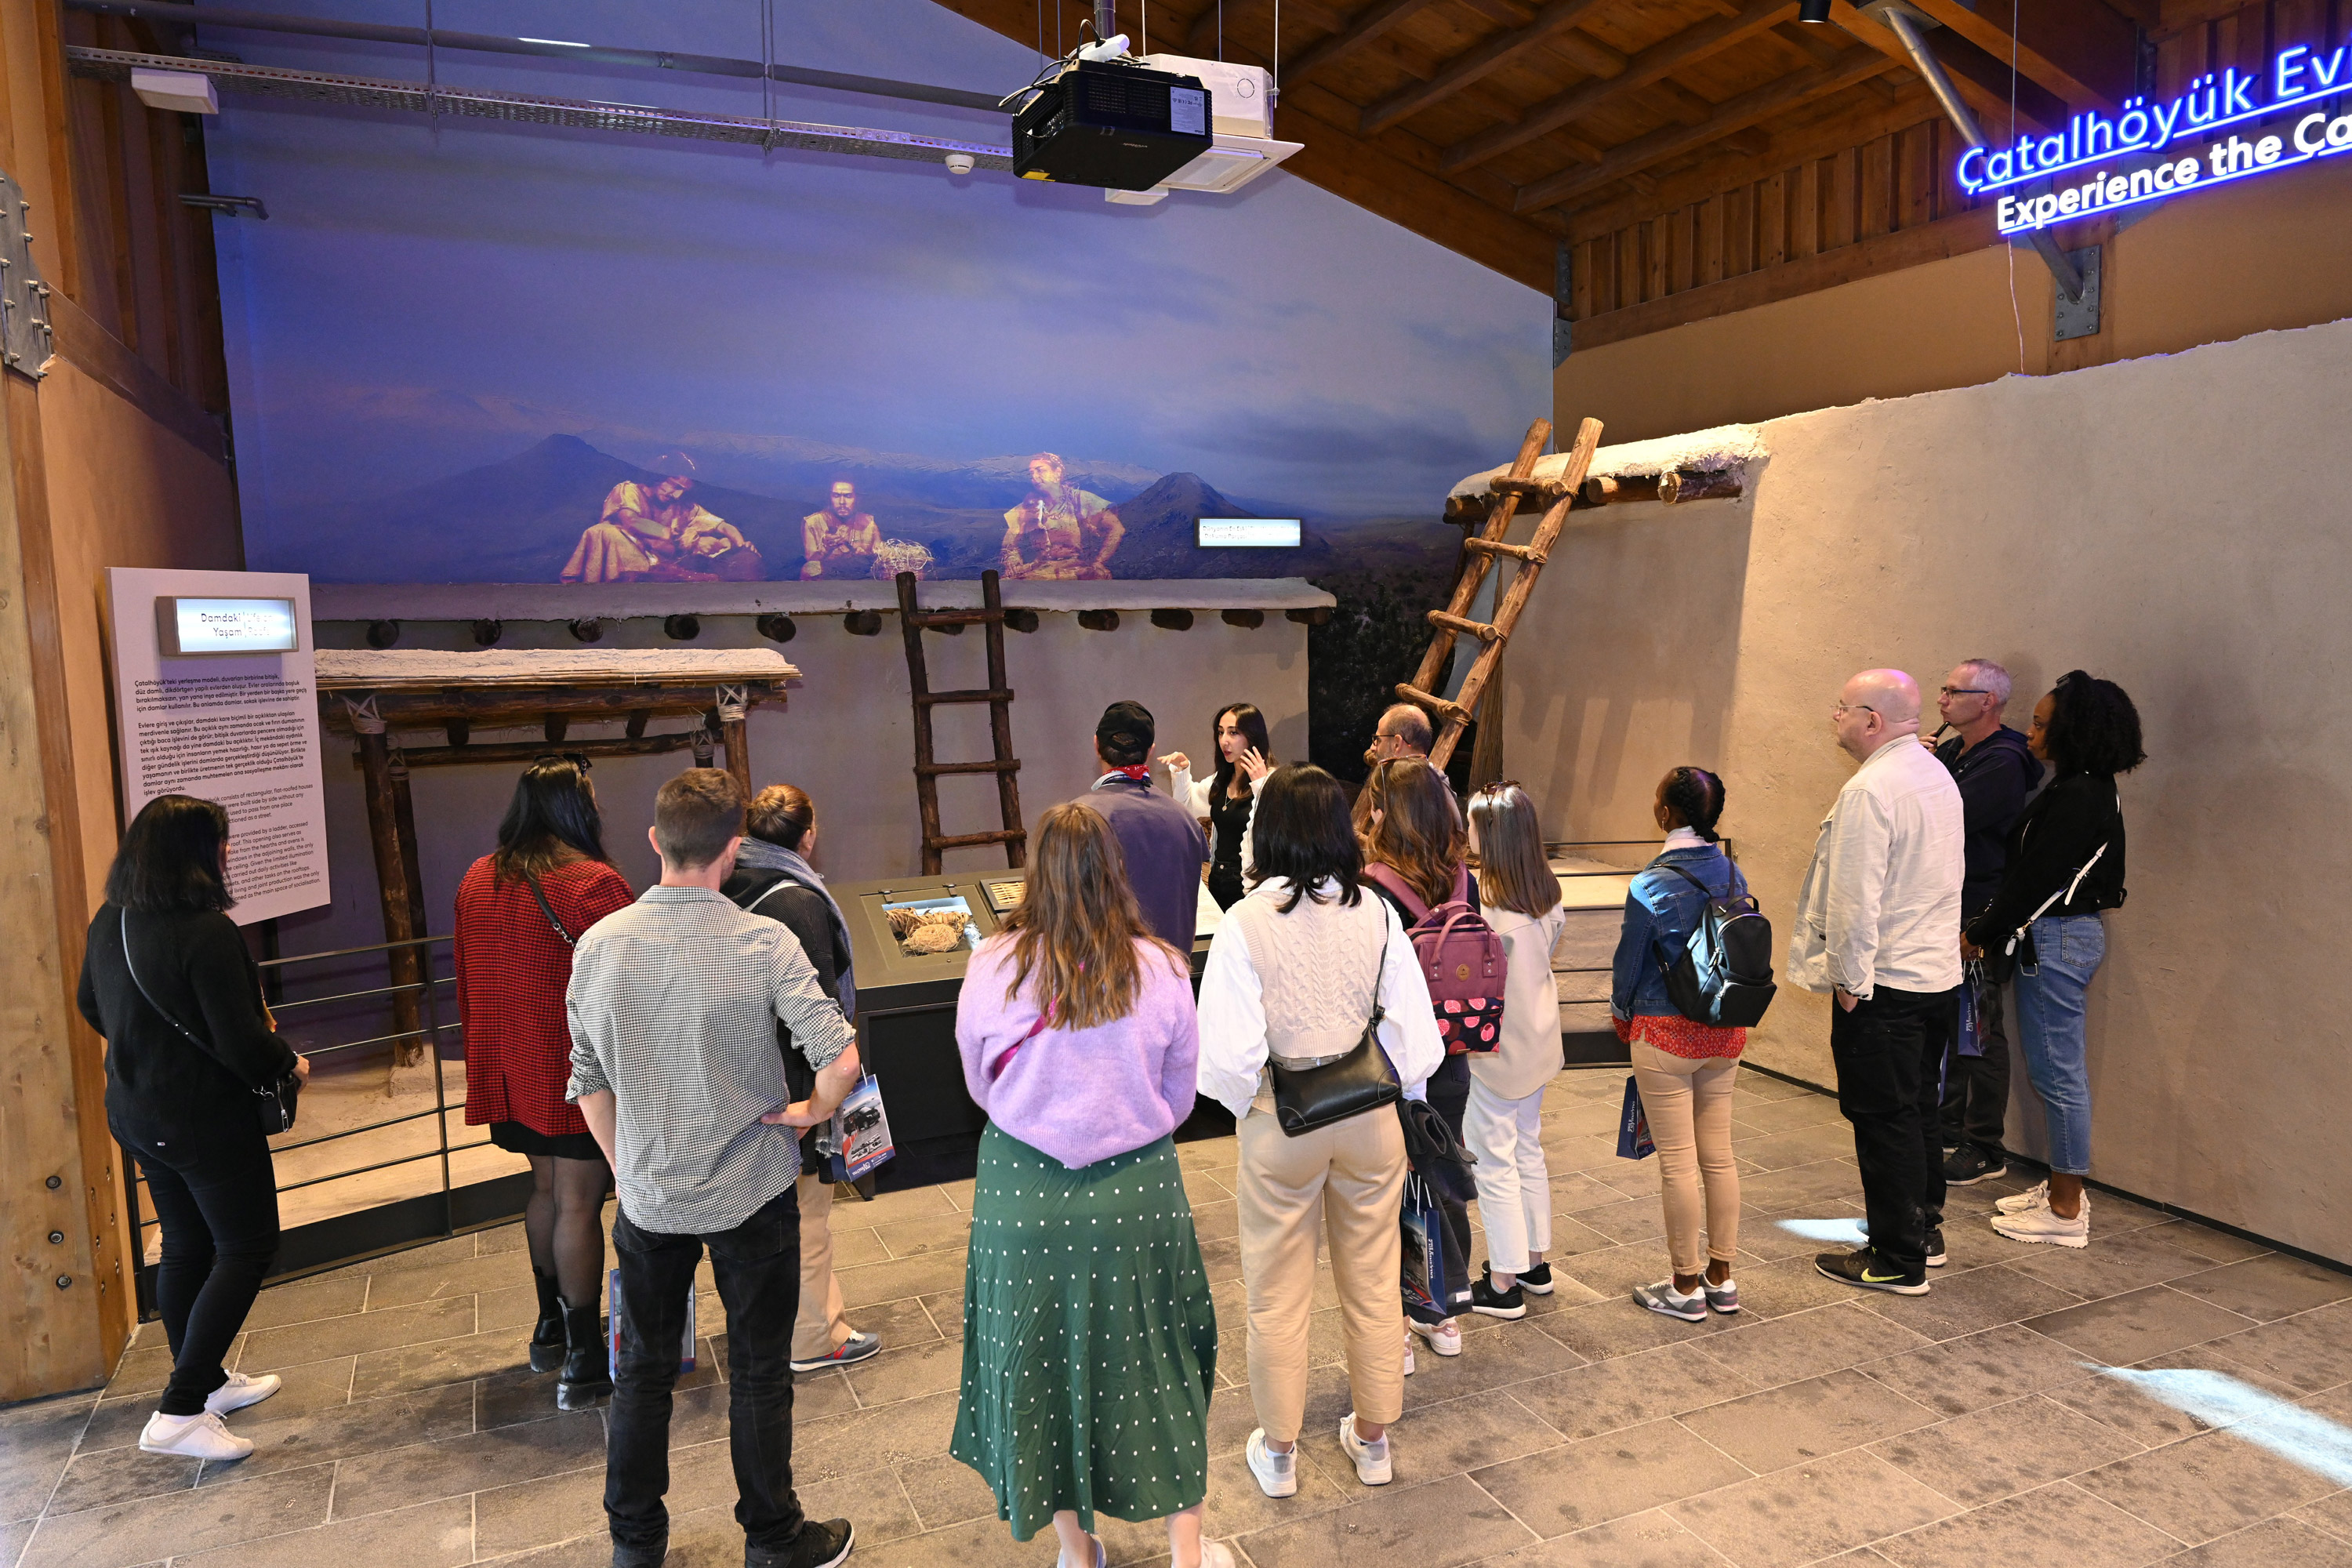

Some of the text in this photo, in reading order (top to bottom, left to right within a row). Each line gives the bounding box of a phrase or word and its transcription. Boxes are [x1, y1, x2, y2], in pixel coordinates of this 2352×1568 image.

[1958, 44, 2352, 194] Çatalhöyük Ev
[1998, 157, 2199, 230] Experience
[2209, 135, 2282, 176] the
[201, 613, 241, 622] Damdaki
[213, 627, 242, 639] Yaşam
[172, 735, 190, 744] işlevini
[198, 733, 214, 742] görür;
[160, 744, 182, 753] kaynağı
[202, 739, 225, 748] damdaki
[212, 747, 229, 756] yemek
[157, 760, 181, 770] gündelik
[181, 758, 198, 767] işlerini
[198, 756, 224, 764] damlarda
[224, 752, 261, 762] gerçekleştirdiği
[142, 771, 172, 780] yaşamanın
[199, 764, 225, 772] üretmenin
[234, 760, 256, 769] gerçeklik
[176, 775, 201, 783] zamanda
[157, 785, 187, 795] görüyordu.
[241, 829, 261, 838] provided
[261, 848, 283, 857] adjoining
[289, 850, 314, 858] illumination
[257, 881, 268, 890] joint
[268, 877, 293, 887] production
[293, 878, 321, 887] socialisation.
